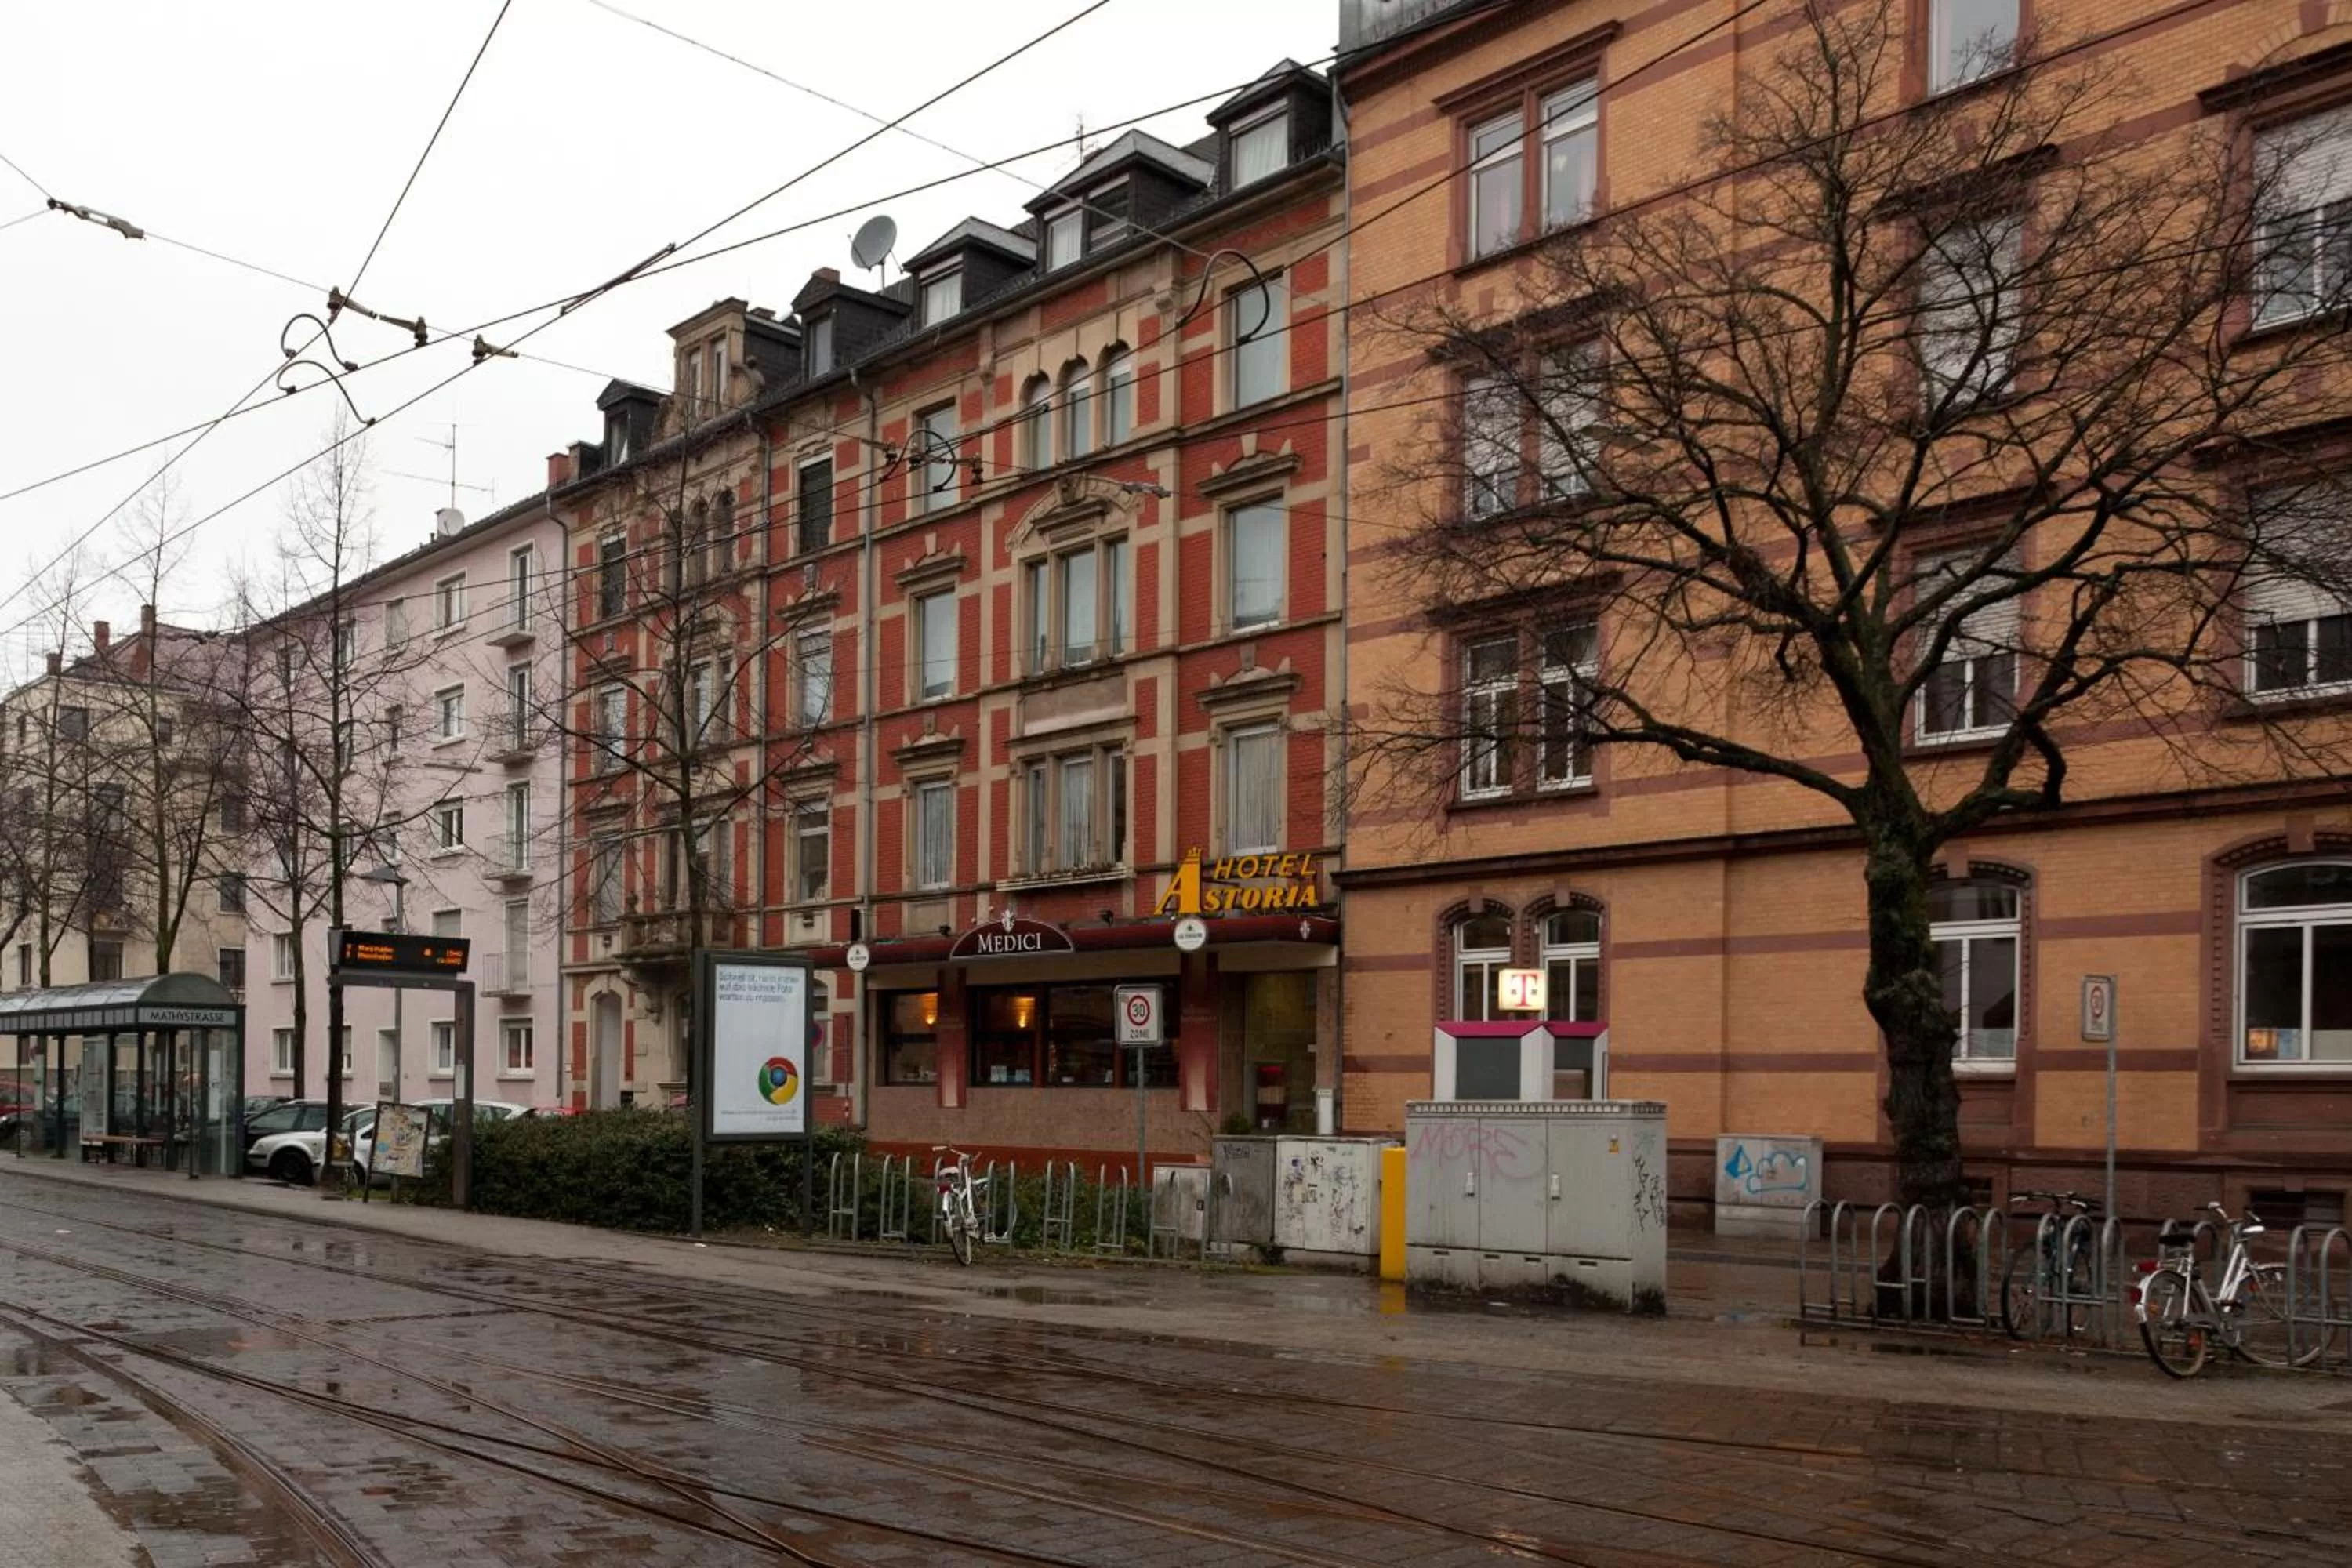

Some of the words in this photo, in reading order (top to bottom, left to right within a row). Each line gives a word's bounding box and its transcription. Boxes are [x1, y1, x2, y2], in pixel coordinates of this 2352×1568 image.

[1214, 853, 1316, 880] HOTEL
[1153, 848, 1319, 915] ASTORIA
[977, 931, 1042, 953] MEDICI
[1510, 973, 1538, 1007] T
[150, 1010, 227, 1023] MATHYSTRASSE
[1131, 1003, 1145, 1018] 30
